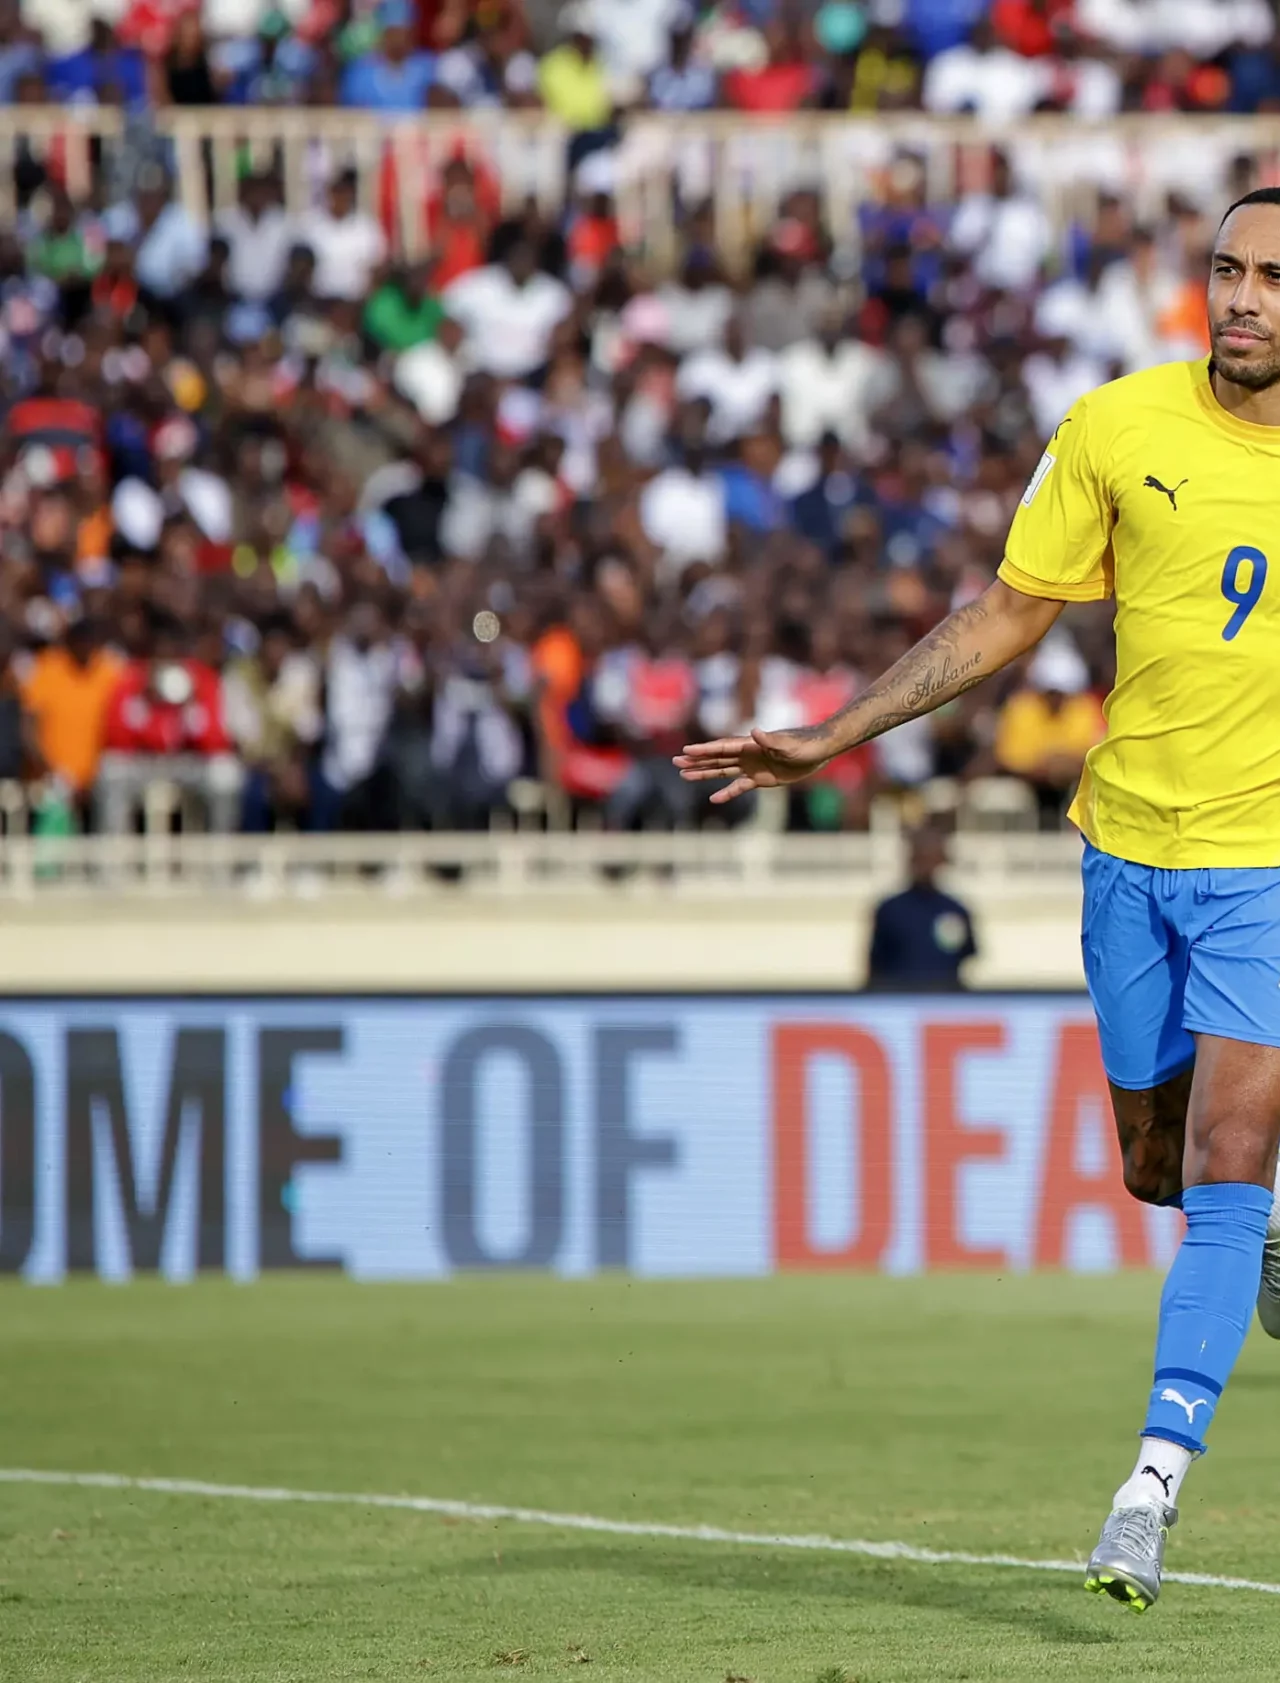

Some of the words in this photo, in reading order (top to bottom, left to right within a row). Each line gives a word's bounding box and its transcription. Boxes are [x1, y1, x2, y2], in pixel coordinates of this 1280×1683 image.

[1221, 545, 1268, 642] 9
[0, 1022, 345, 1269] ME
[438, 1018, 682, 1268] OF
